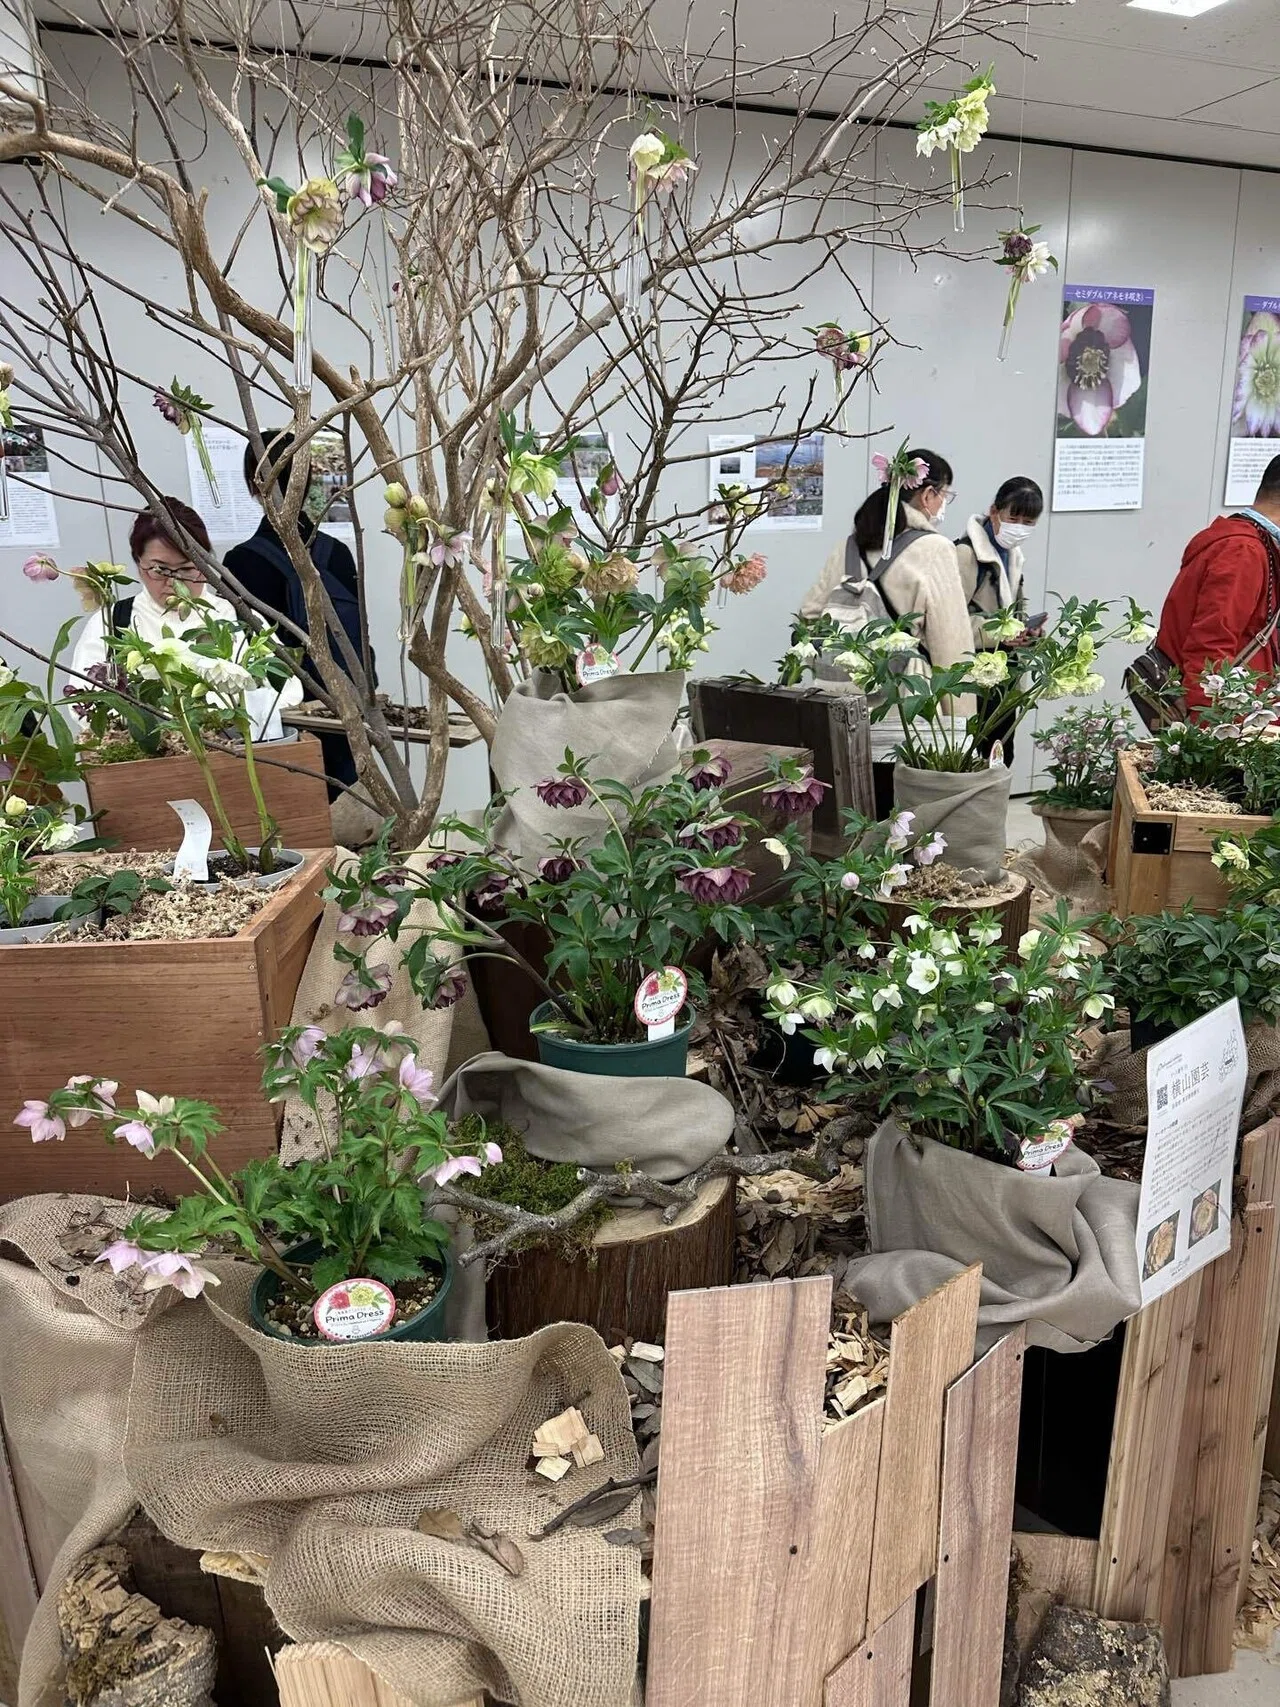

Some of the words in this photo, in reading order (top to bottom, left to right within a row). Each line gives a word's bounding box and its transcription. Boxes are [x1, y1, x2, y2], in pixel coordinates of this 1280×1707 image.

[641, 999, 662, 1010] Prima
[662, 993, 680, 1003] Dress
[1024, 1148, 1044, 1156] Prima
[1044, 1142, 1064, 1152] Dress
[325, 1315, 355, 1324] Prima
[356, 1309, 385, 1319] Dress
